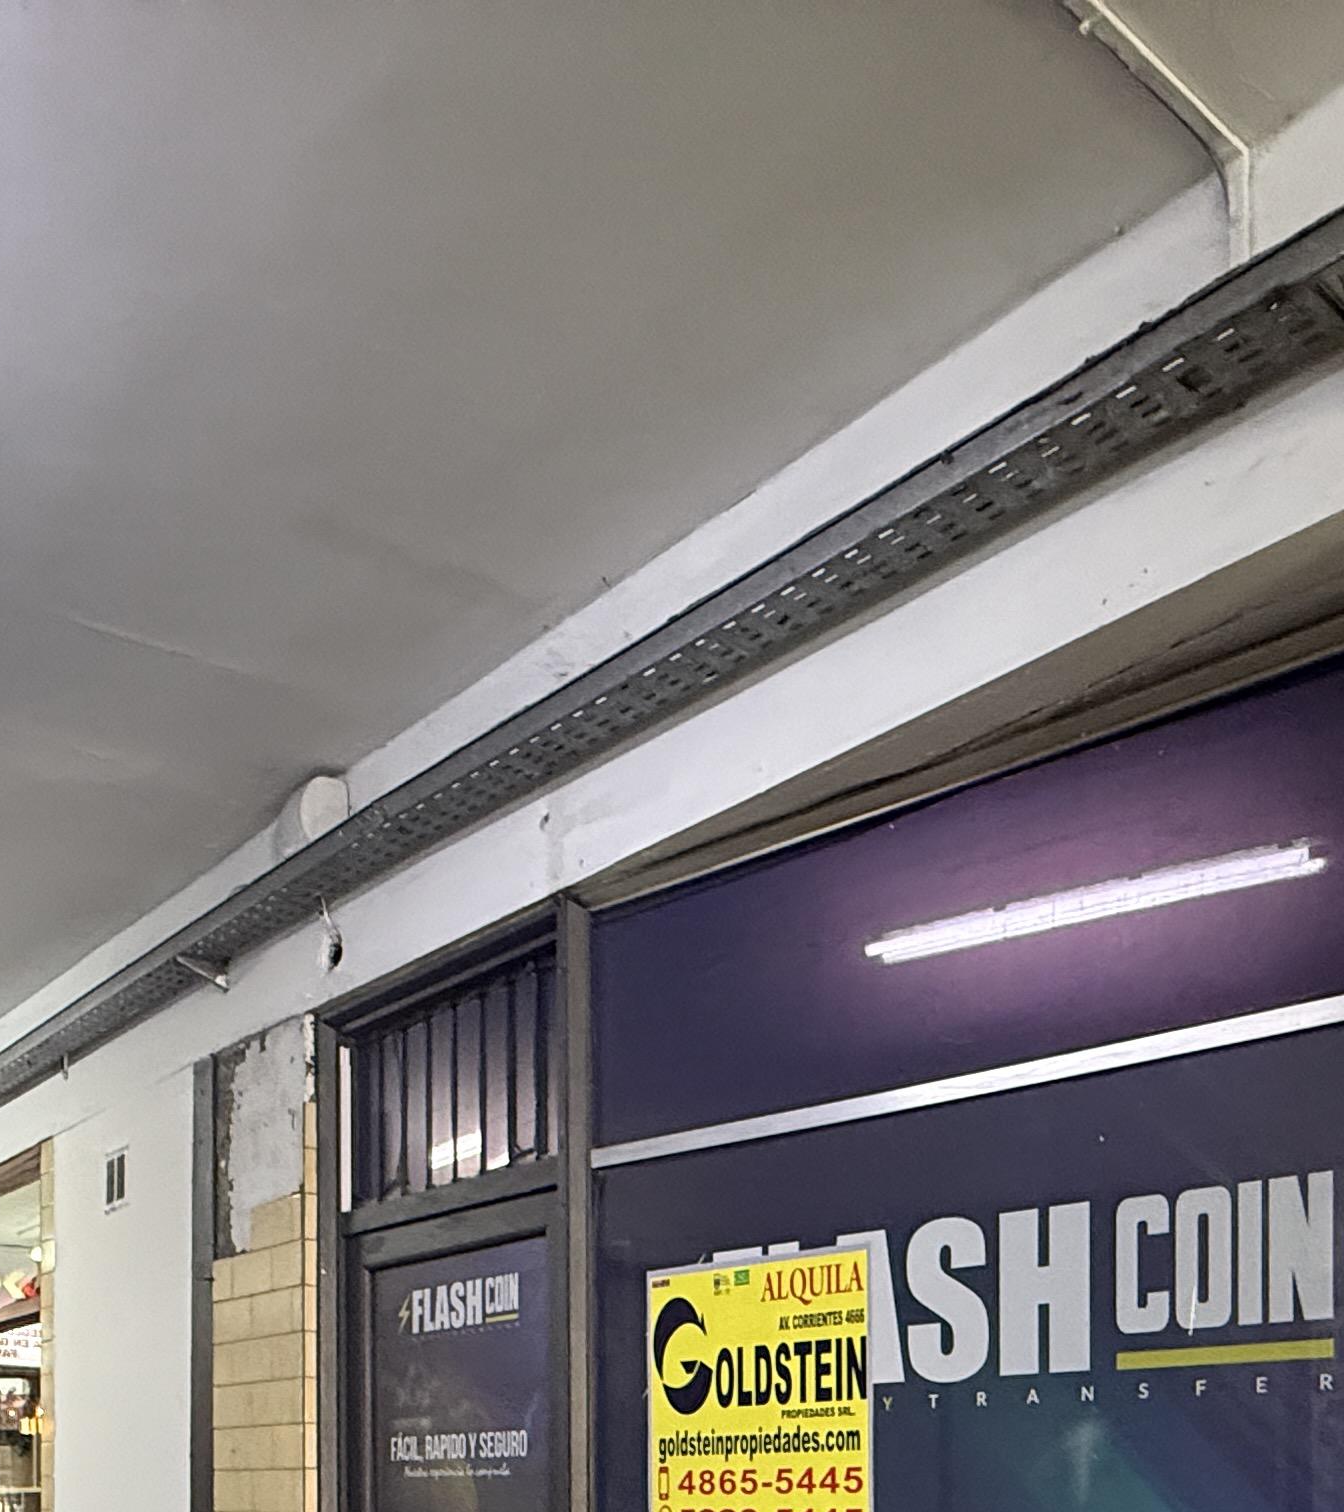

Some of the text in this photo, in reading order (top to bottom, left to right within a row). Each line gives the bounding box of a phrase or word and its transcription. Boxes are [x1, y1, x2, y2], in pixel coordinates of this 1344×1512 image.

[1116, 1171, 1333, 1334] COIN
[412, 1278, 483, 1334] FLASH
[485, 1272, 519, 1314] COIN
[760, 1261, 864, 1305] ALQUILA
[654, 1297, 867, 1415] GOLDSTEIN
[468, 1432, 477, 1459] Y
[479, 1429, 528, 1458] SEGURO
[658, 1426, 861, 1463] goldsteinpropiedades.com
[678, 1466, 864, 1495] 4865-5445
